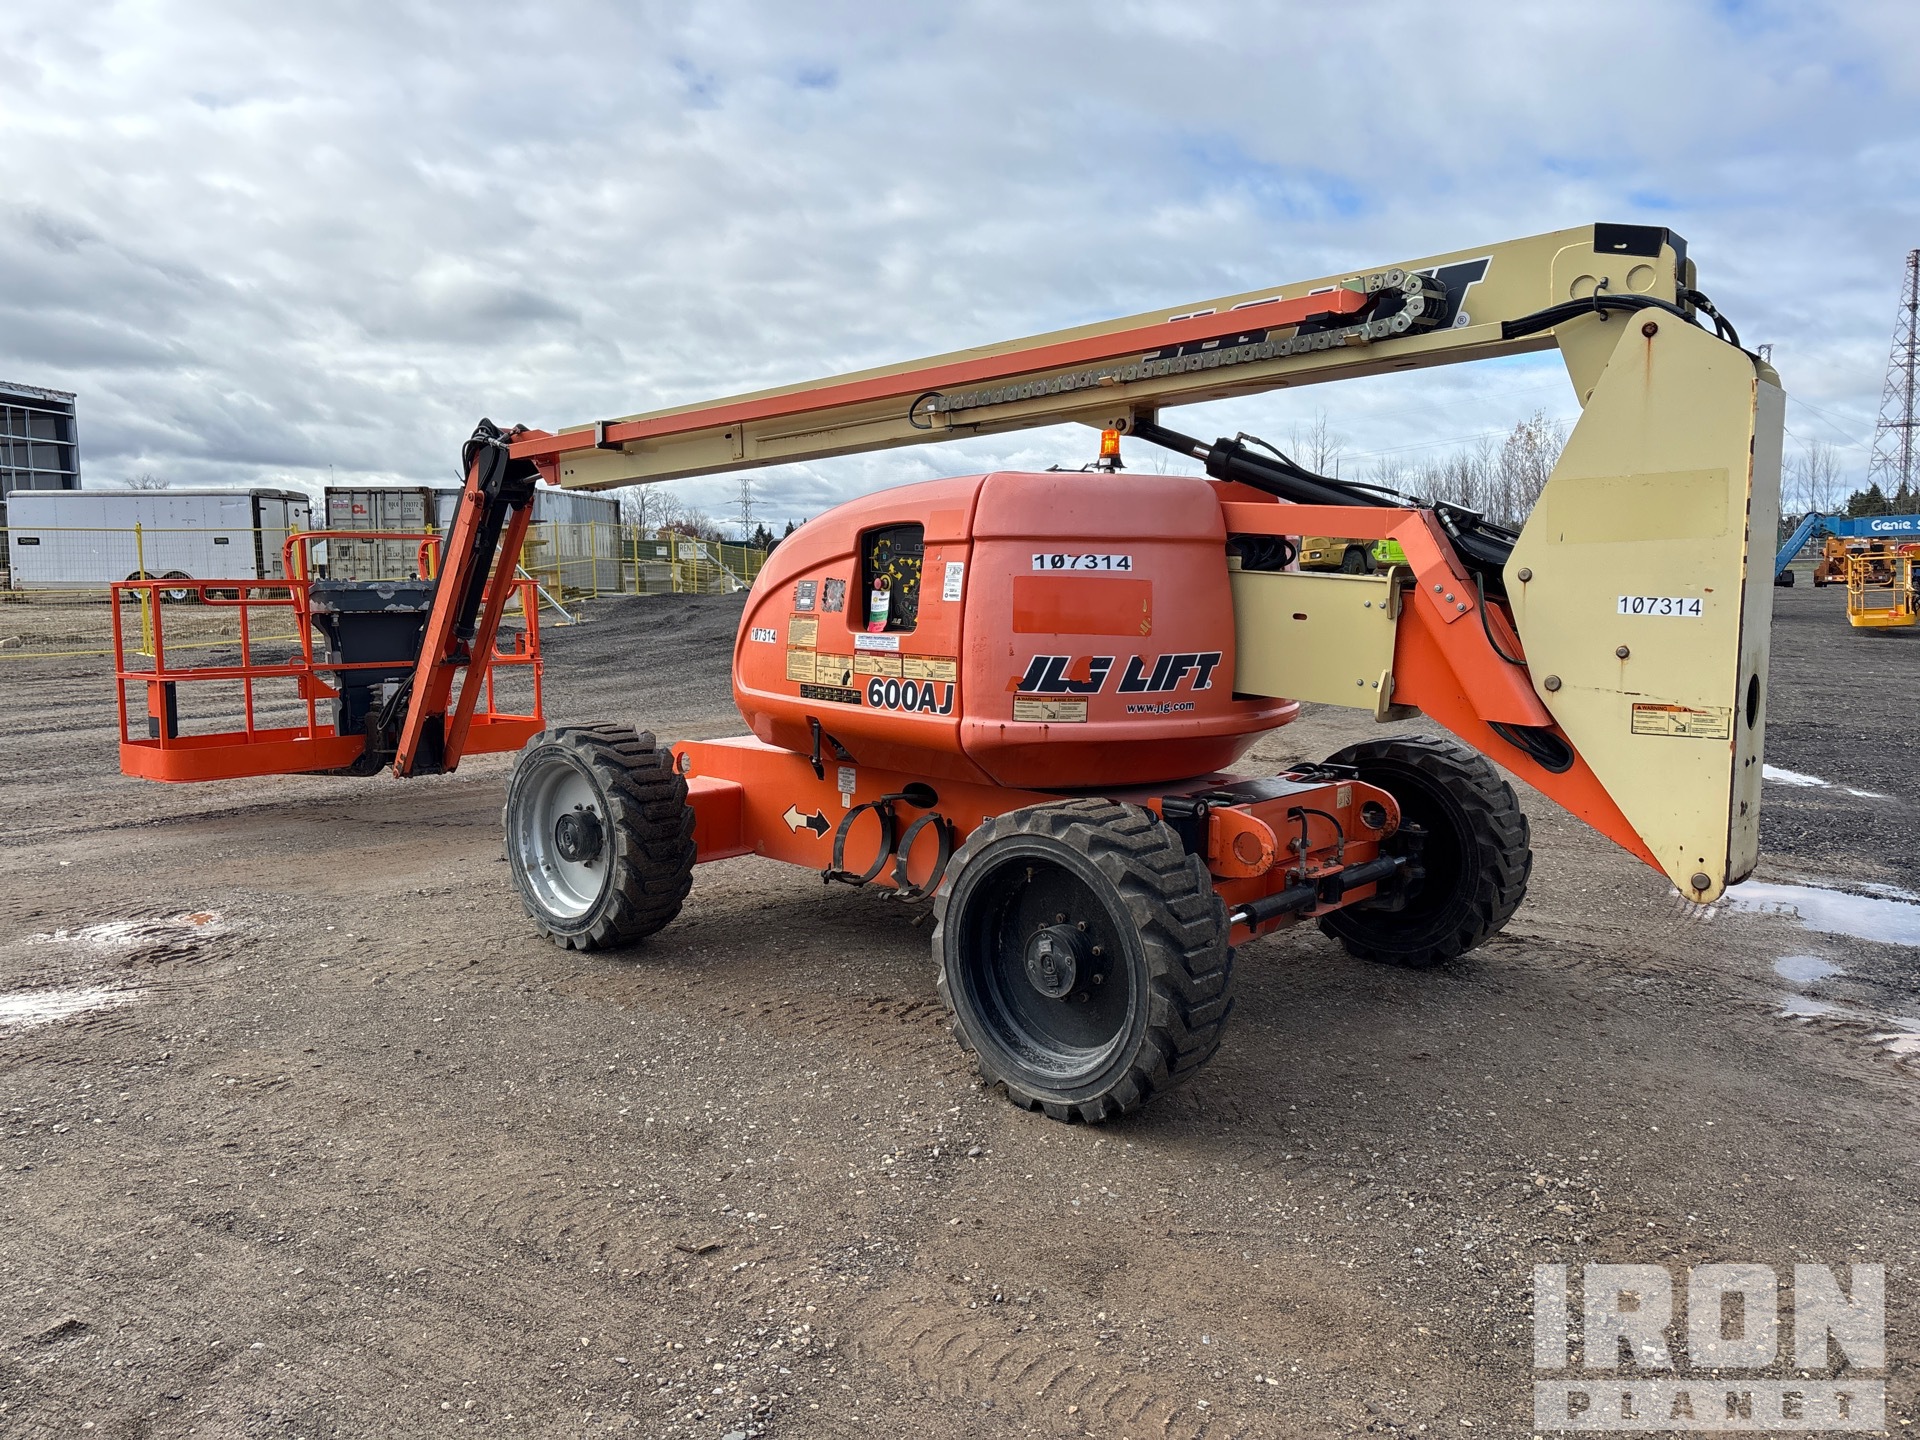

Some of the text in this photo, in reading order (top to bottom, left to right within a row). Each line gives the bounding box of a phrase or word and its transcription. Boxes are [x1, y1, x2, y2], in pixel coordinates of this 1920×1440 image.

[1871, 519, 1911, 531] Genie
[1034, 554, 1131, 571] 107314
[1620, 597, 1702, 616] 107314
[752, 628, 776, 642] 107314
[1014, 651, 1223, 694] JLG LIFT
[867, 677, 955, 715] 600AJ
[1127, 701, 1195, 714] www.jlg.com
